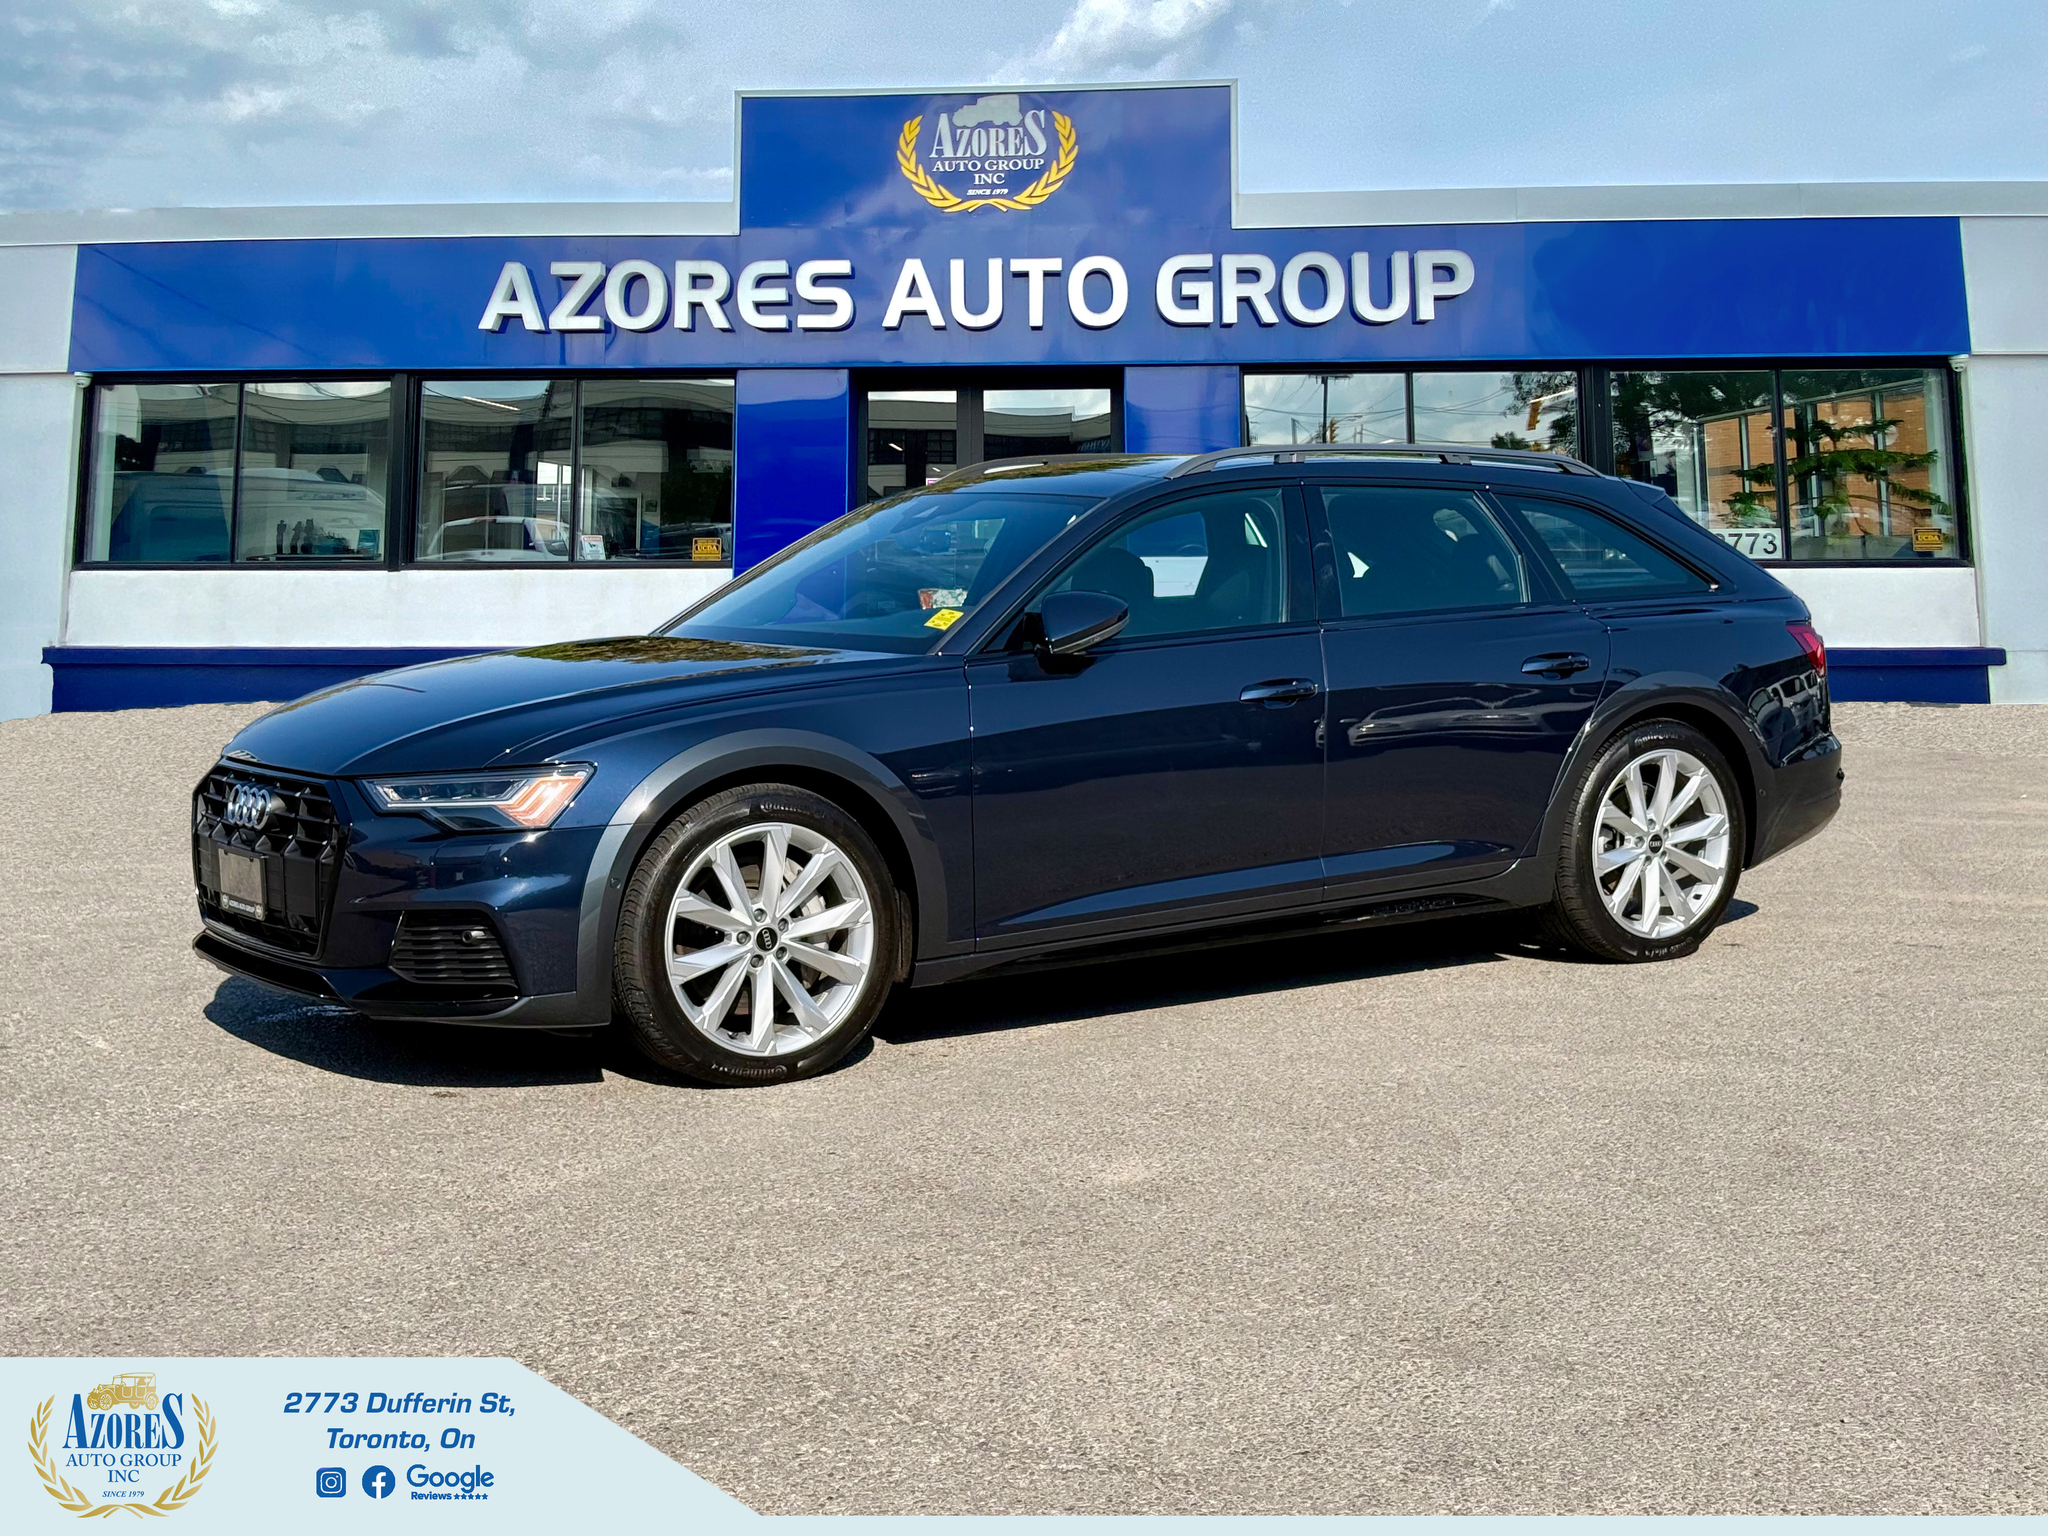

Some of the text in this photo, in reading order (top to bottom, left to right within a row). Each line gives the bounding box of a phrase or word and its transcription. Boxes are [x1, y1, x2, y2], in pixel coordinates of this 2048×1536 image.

[929, 110, 1047, 158] AZORES
[932, 158, 1044, 172] AUTO GROUP
[973, 173, 1005, 185] INC
[477, 249, 1475, 333] AZORES AUTO GROUP
